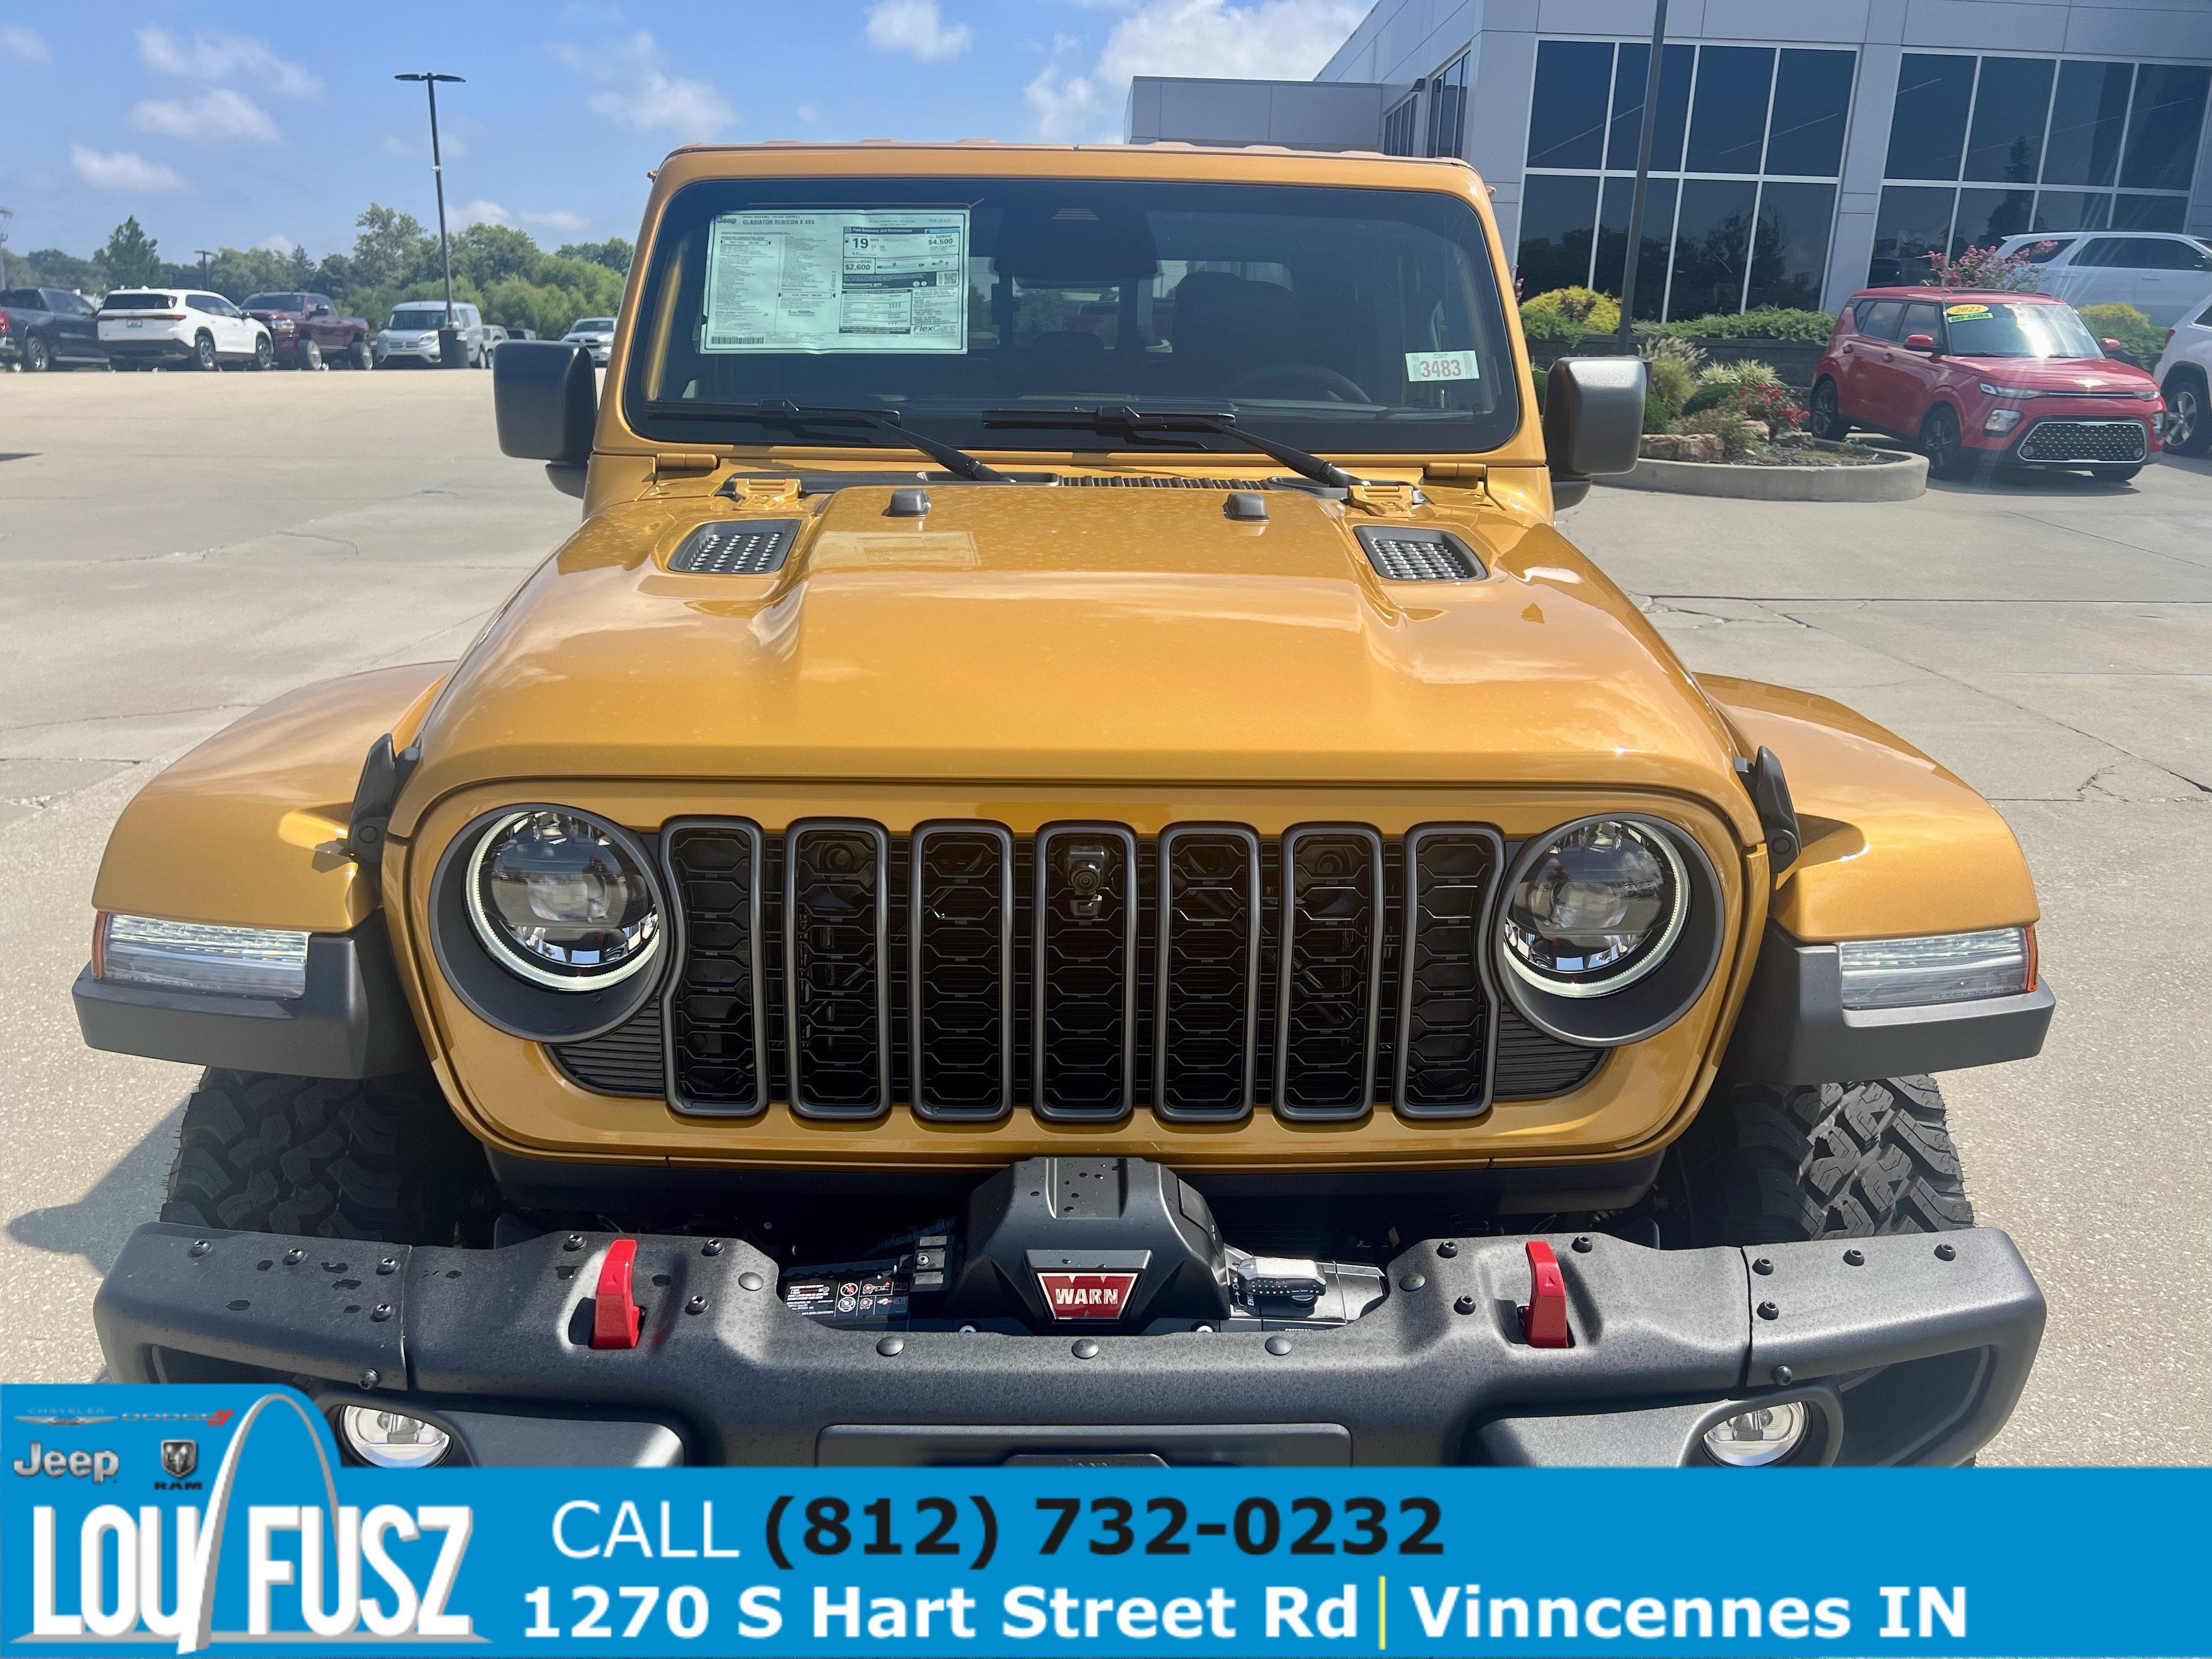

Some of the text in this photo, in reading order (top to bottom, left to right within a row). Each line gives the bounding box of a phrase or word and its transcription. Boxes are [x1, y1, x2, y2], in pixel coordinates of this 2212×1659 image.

[853, 238, 869, 249] 19
[1420, 359, 1462, 377] 3483
[1055, 1288, 1119, 1305] WARN
